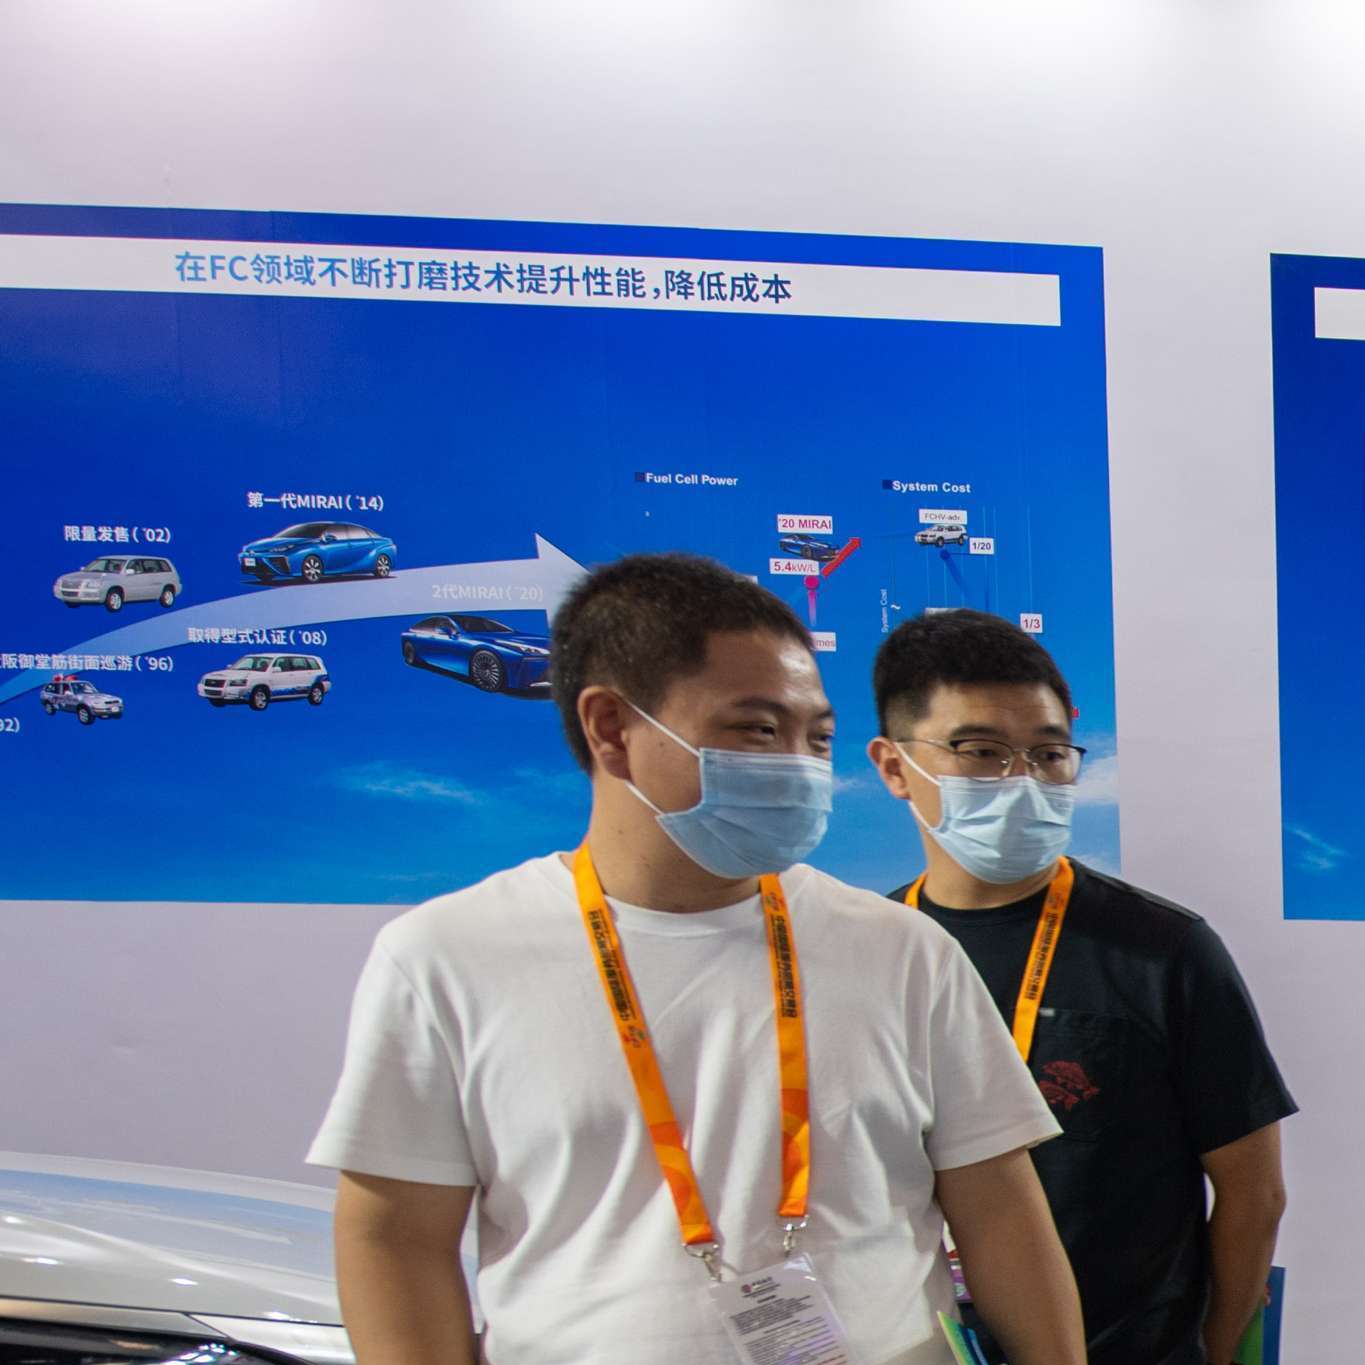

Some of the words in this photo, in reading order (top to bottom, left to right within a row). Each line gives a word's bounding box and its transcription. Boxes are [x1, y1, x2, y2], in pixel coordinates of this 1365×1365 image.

[645, 472, 672, 484] Fuel
[675, 474, 698, 484] Cell
[702, 475, 738, 486] Power
[892, 480, 938, 494] System
[942, 482, 971, 493] Cost
[798, 519, 831, 529] MIRAI
[972, 542, 991, 551] 1/20
